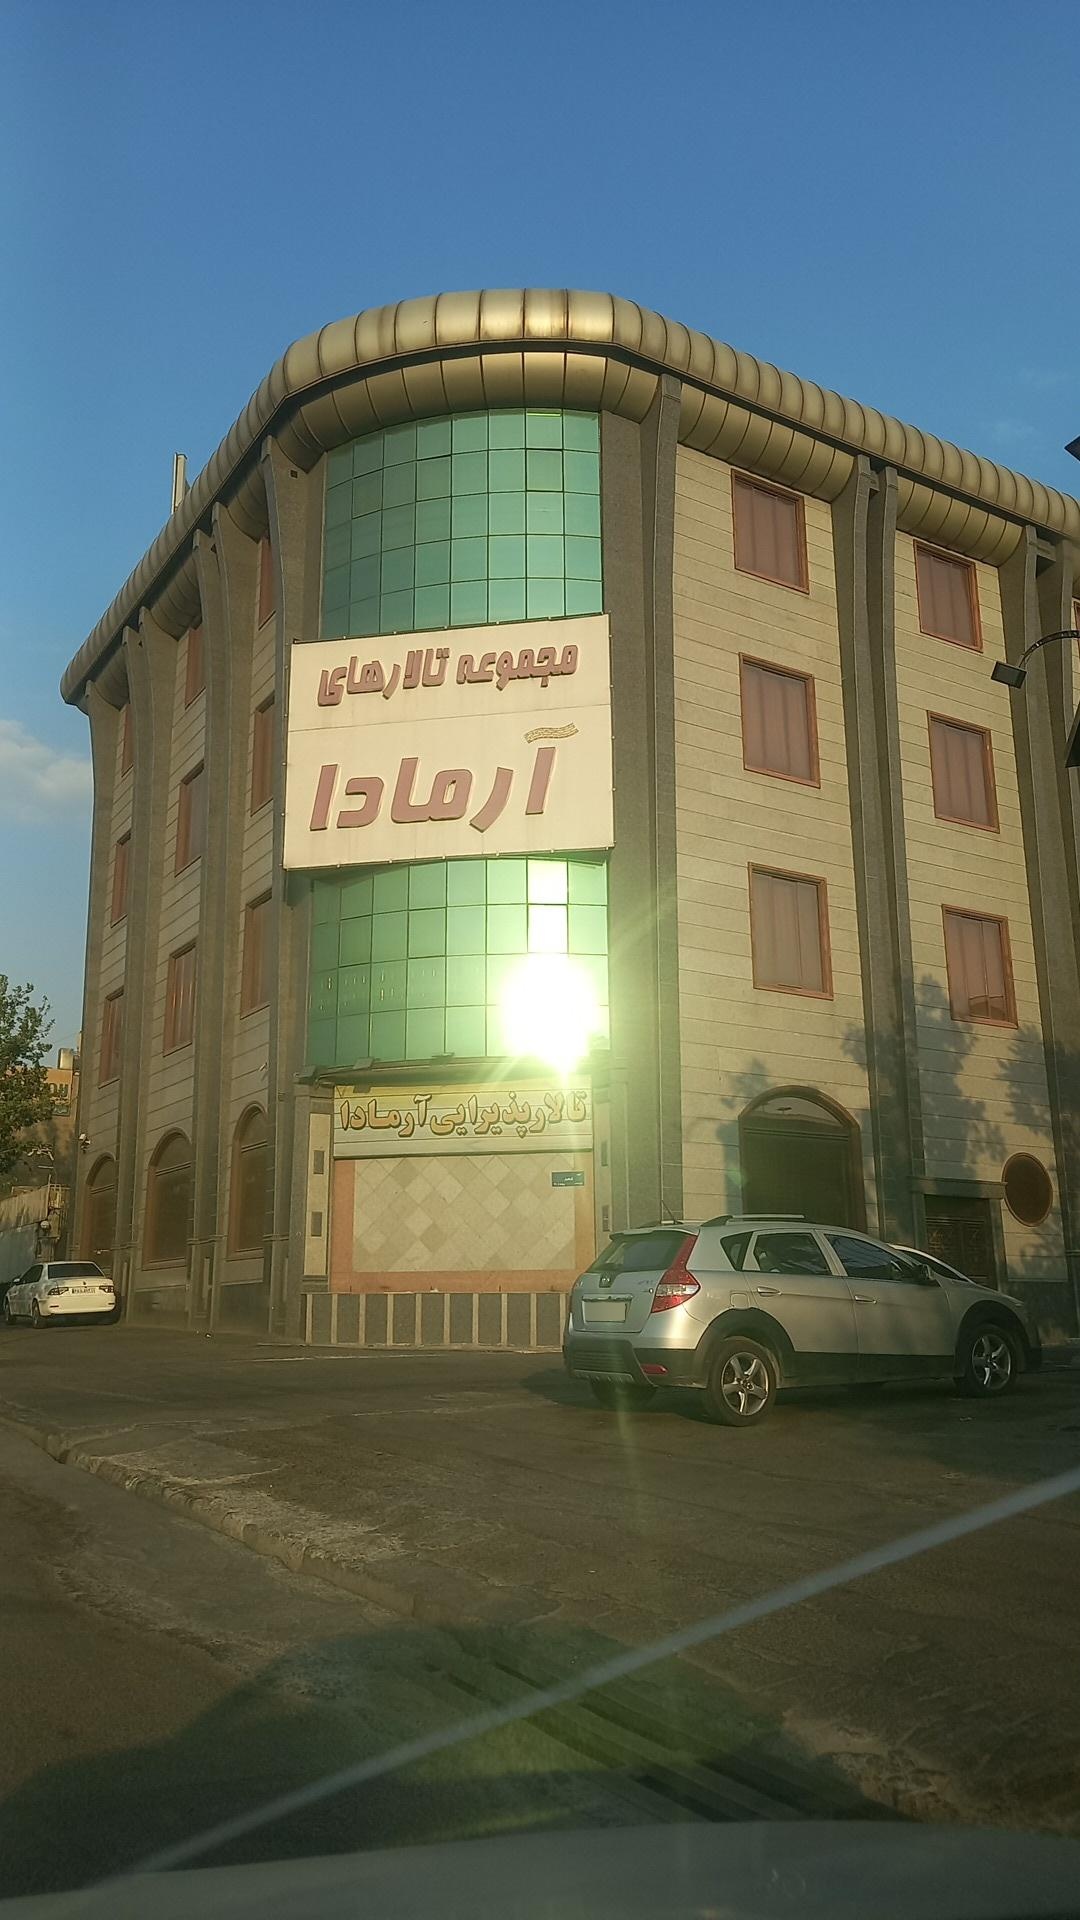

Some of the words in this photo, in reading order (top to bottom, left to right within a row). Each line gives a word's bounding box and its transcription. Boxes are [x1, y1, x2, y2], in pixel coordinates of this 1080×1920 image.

[317, 647, 450, 707] تالارهای
[456, 644, 579, 692] مجموعه
[309, 722, 579, 833] آرمادا
[340, 1094, 433, 1137] آرمادا
[430, 1091, 531, 1138] پذیرایی
[528, 1091, 588, 1133] تالار
